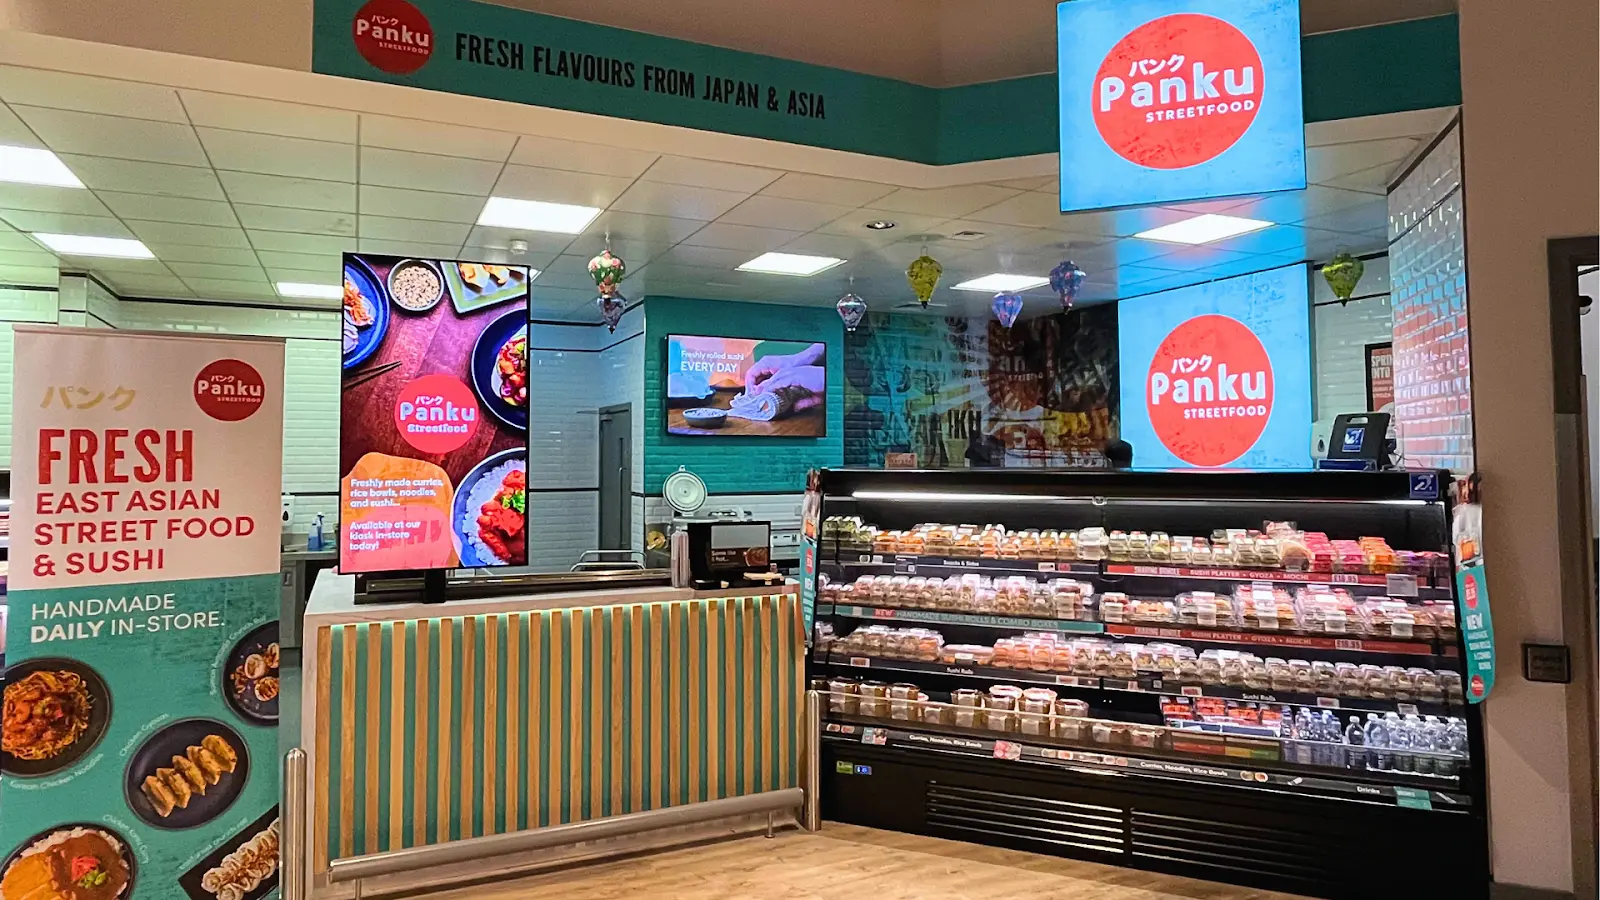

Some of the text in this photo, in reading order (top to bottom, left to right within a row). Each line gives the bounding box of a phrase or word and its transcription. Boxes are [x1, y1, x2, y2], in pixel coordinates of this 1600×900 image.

[371, 15, 399, 26] パンク
[356, 18, 429, 47] Panku
[379, 41, 429, 55] STREETFOOD
[1129, 53, 1185, 77] パンク
[456, 32, 826, 120] FRESH FLAVOURS FROM JAPAN & ASIA
[1100, 62, 1255, 112] Panku
[1145, 100, 1255, 123] STREETFOOD
[681, 350, 705, 360] Freshly
[706, 351, 726, 360] rolled
[681, 361, 737, 373] EVERY DAY
[1171, 354, 1213, 374] パンク
[1372, 366, 1391, 379] INTO
[198, 380, 261, 397] Panku
[1151, 363, 1266, 405] Panku
[40, 385, 136, 411] パンク
[415, 395, 444, 406] パンク
[400, 401, 475, 421] Panku
[1184, 404, 1266, 419] STREETFOOD
[407, 423, 468, 433] Streetfood
[38, 429, 193, 485] FRESH
[350, 478, 444, 488] Freshly made curries,
[350, 488, 437, 498] rice bowls, noodles,
[36, 489, 220, 515] EAST ASIAN
[350, 499, 368, 508] and
[34, 516, 255, 546] STREET FOOD
[350, 521, 392, 530] Available
[350, 531, 410, 540] kiosk in-store
[350, 542, 379, 551] today!
[33, 548, 164, 577] & SUSHI
[31, 593, 176, 620] HANDMADE
[31, 611, 225, 644] DAILY IN-STORE.
[897, 611, 940, 620] HANDMADE
[991, 616, 996, 624] &
[998, 617, 1030, 626] COMBO
[1031, 619, 1058, 628] BOXES
[1212, 632, 1241, 640] PLATTER
[1251, 635, 1276, 643] GYOZA
[119, 730, 142, 757] Chicken
[9, 753, 104, 790] Korean Chicken Noodles
[1356, 786, 1380, 794] Drinks
